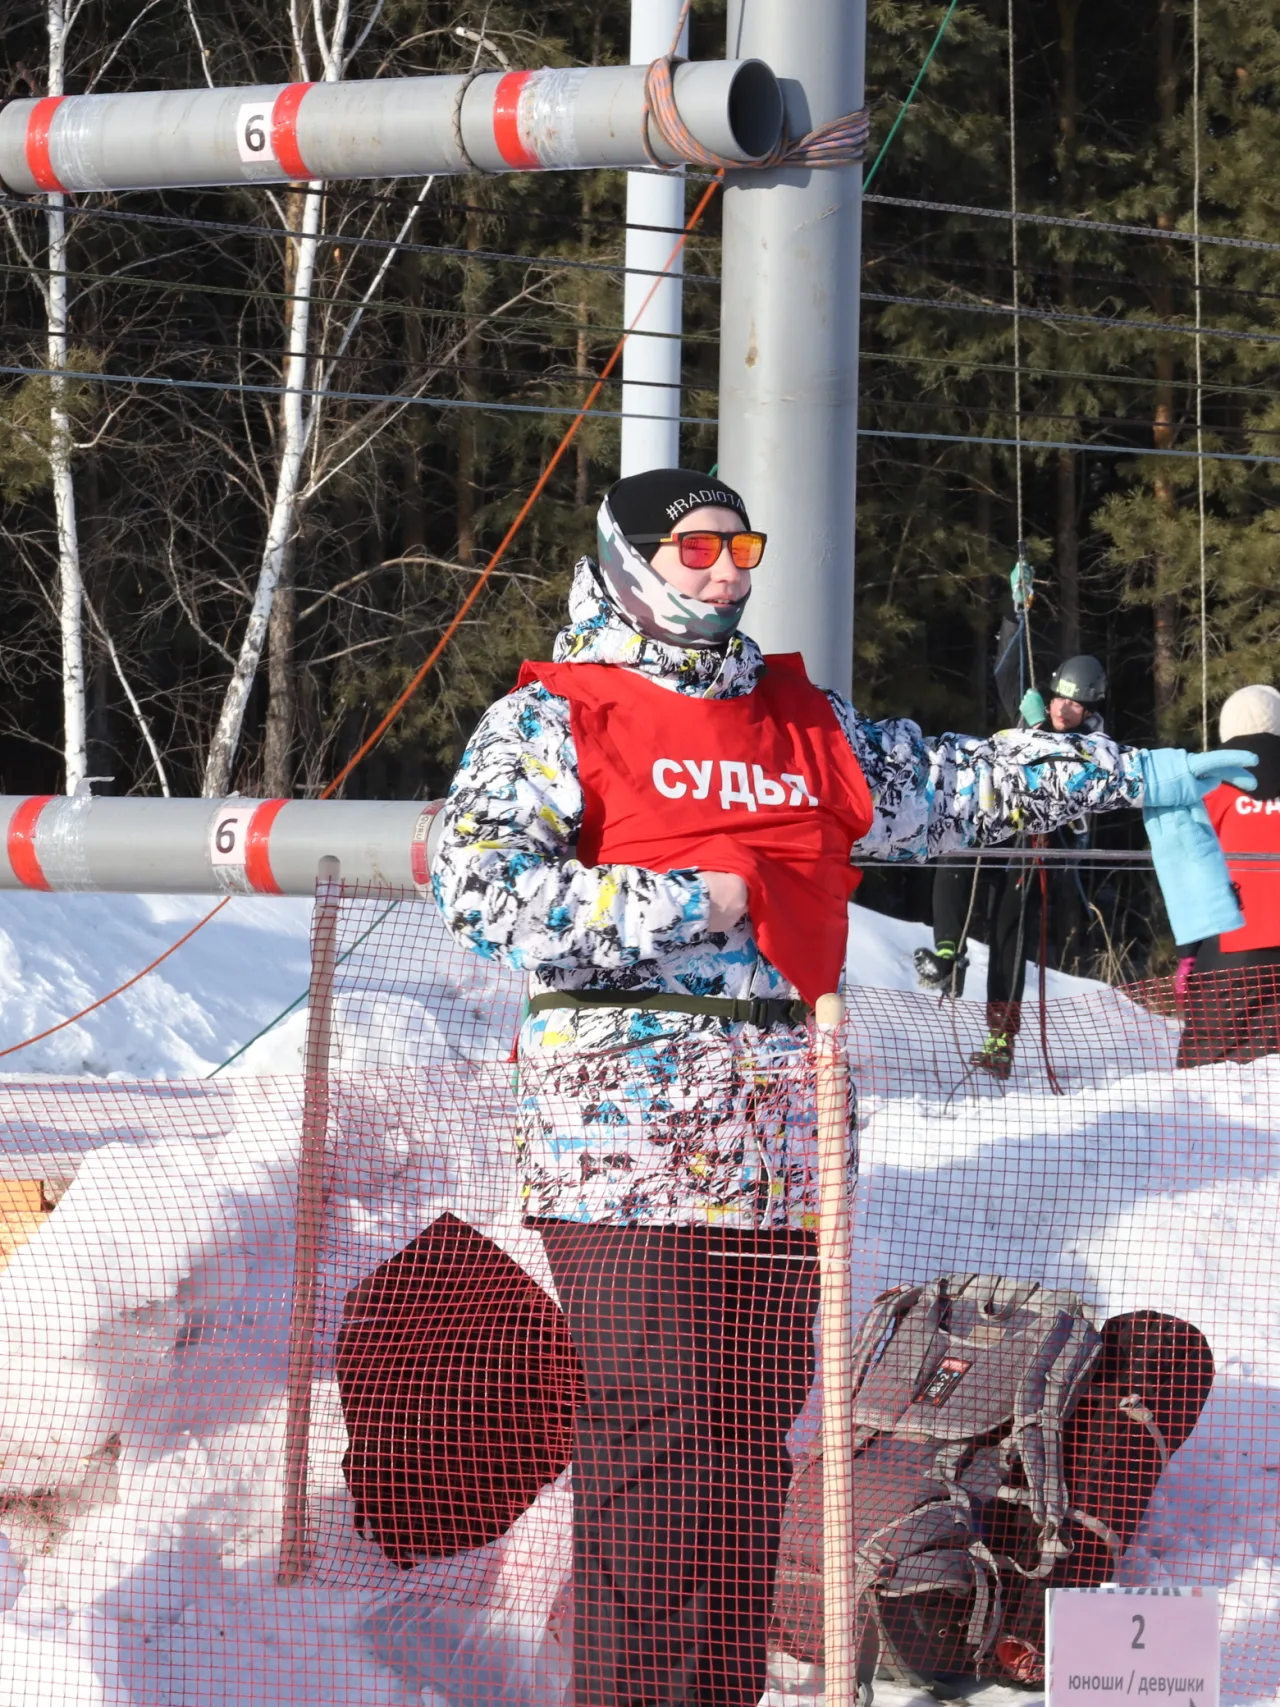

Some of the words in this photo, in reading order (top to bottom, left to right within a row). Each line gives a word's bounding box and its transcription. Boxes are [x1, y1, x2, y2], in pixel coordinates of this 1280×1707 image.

[244, 114, 266, 152] 6
[652, 758, 819, 812] СУДЬЯ
[215, 817, 238, 854] 6
[1131, 1614, 1146, 1650] 2
[1068, 1674, 1124, 1691] юноши
[1126, 1669, 1136, 1696] /
[1137, 1676, 1205, 1697] девушки
